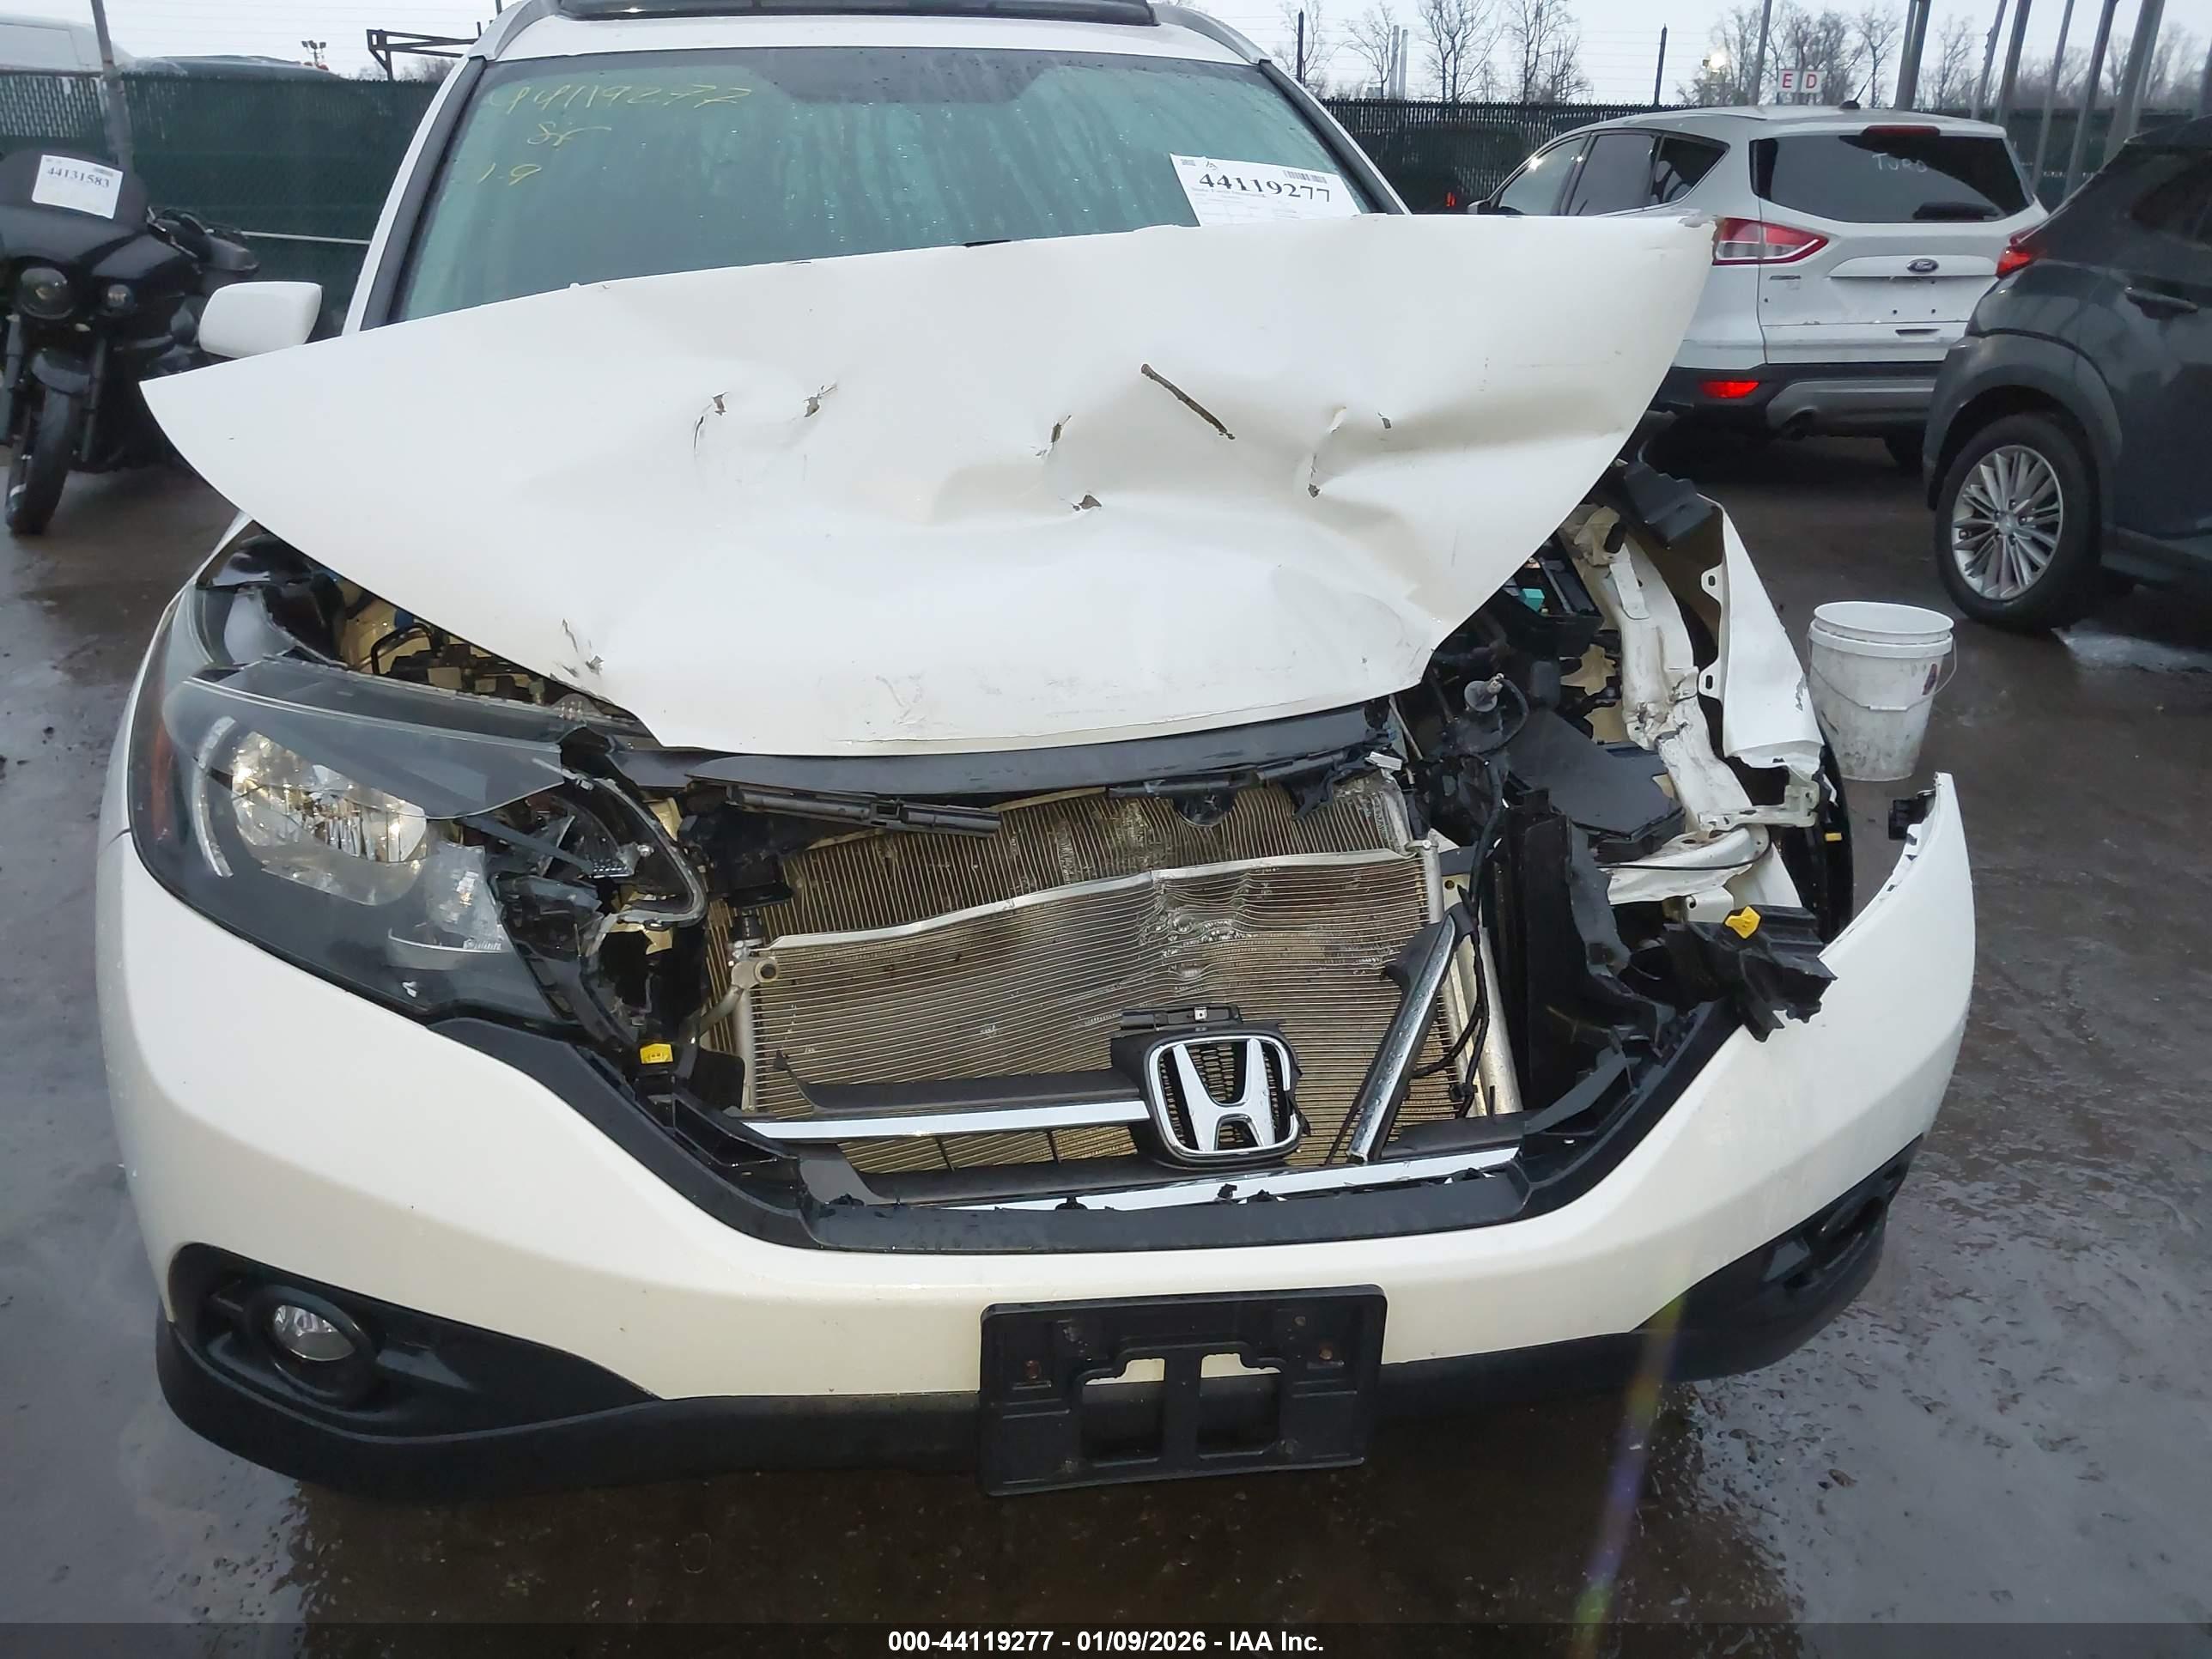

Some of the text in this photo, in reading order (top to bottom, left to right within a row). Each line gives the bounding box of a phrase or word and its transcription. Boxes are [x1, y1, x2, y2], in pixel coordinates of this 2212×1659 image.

[1782, 73, 1818, 89] E D
[48, 166, 110, 189] 44131583
[1199, 173, 1330, 203] 44119277
